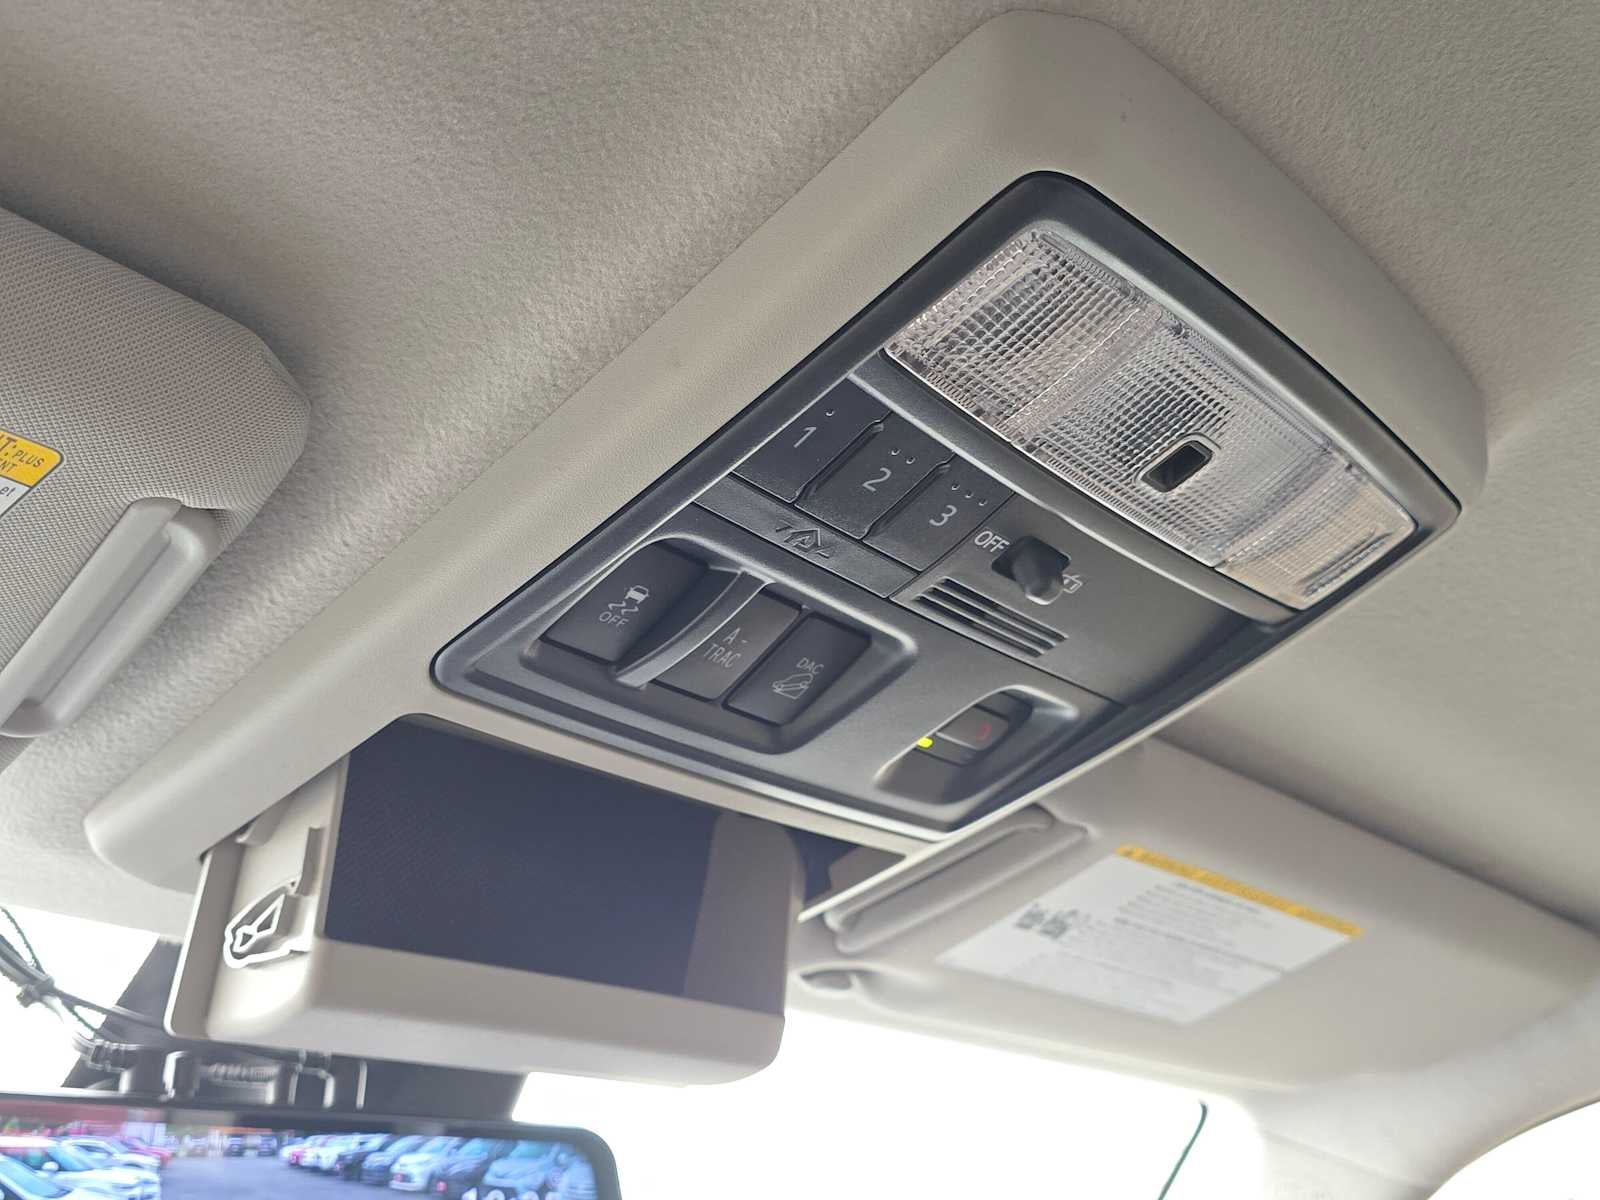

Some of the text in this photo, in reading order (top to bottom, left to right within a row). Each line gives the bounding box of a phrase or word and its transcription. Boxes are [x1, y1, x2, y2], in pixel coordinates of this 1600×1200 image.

[793, 425, 817, 448] 1
[12, 449, 45, 468] PLUS
[861, 466, 893, 493] 2
[928, 504, 958, 528] 3
[974, 530, 1011, 552] OFF
[599, 611, 630, 628] OFF
[703, 642, 743, 670] TRAC
[796, 656, 825, 676] DAC
